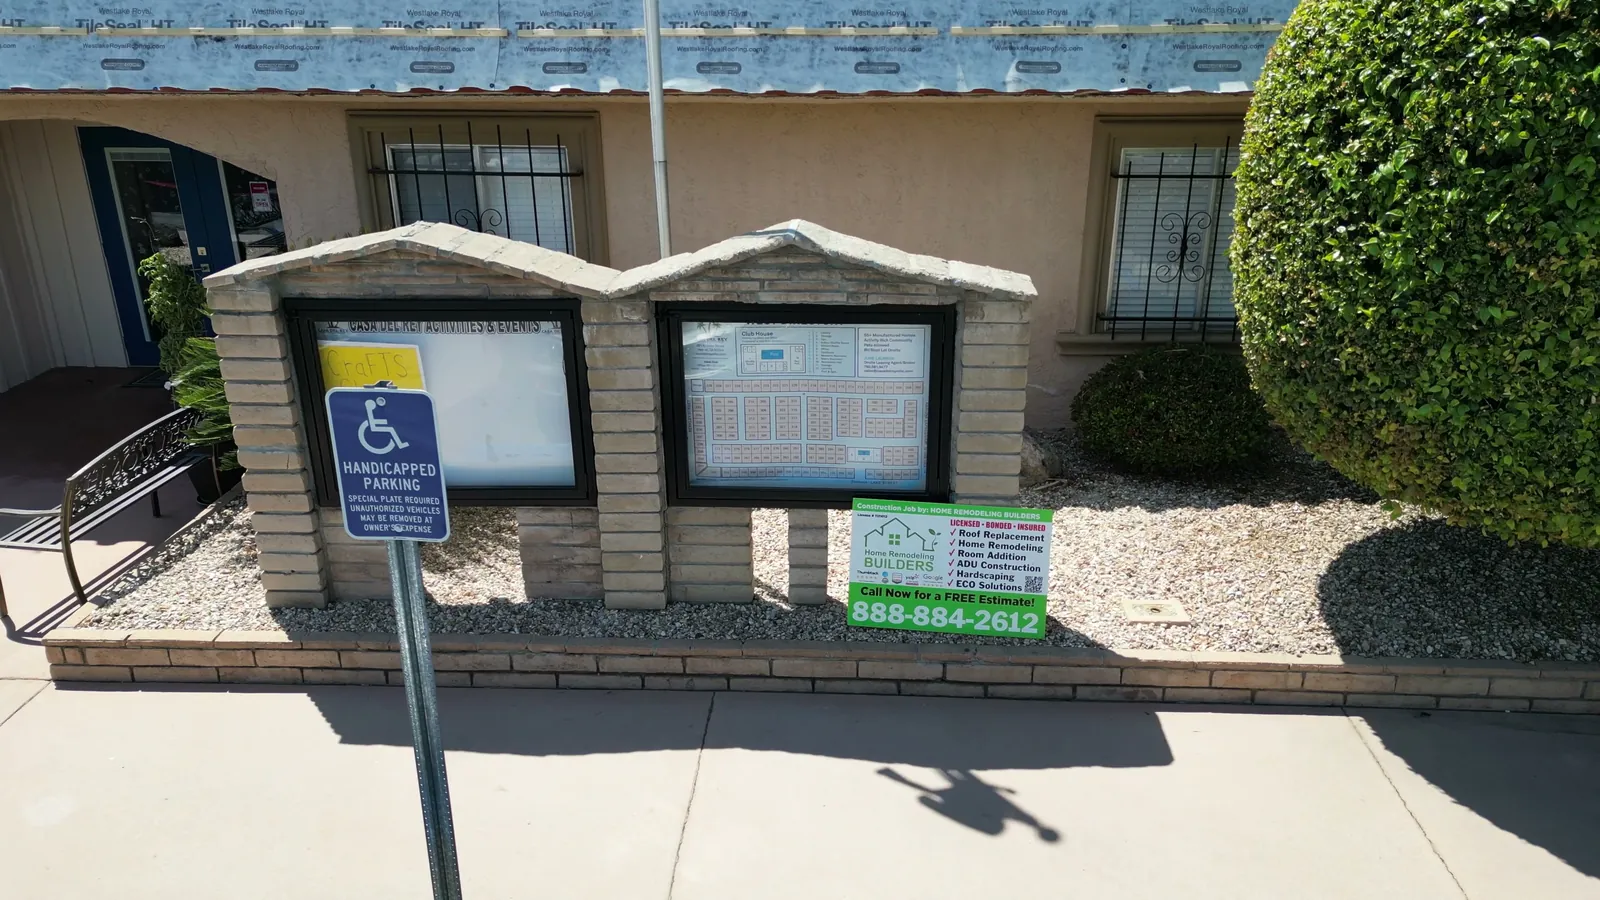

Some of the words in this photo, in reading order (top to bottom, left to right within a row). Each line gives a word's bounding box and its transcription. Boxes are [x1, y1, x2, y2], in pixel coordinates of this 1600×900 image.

[132, 8, 152, 16] Royal
[285, 8, 305, 16] Royal
[407, 9, 439, 17] Westlake
[887, 9, 906, 17] Royal
[1227, 6, 1248, 14] Royal
[349, 321, 378, 334] CASA
[379, 321, 402, 334] DEL
[486, 321, 496, 334] &
[343, 461, 436, 477] HANDICAPPED
[364, 478, 421, 491] PARKING
[348, 495, 377, 503] SPECIAL
[381, 495, 403, 503] PLATE
[405, 496, 440, 505] REQUIRED
[350, 505, 404, 513] UNAUTHORIZED
[406, 506, 440, 515] VEHICLES
[857, 503, 901, 511] Construction
[954, 509, 1002, 518] REMODELING
[1004, 512, 1040, 520] BUILDERS
[390, 515, 422, 523] REMOVED
[402, 525, 432, 533] EXPENSE
[950, 519, 980, 527] LICENSED
[986, 521, 1012, 530] BONDED
[1017, 523, 1046, 532] INSURED
[959, 529, 980, 538] Roof
[984, 531, 1044, 542] Replacement
[958, 539, 985, 548] Home
[988, 541, 1043, 553] Remodeling
[865, 549, 886, 557] Home
[889, 550, 934, 561] Remodeling
[958, 550, 984, 558] Room
[987, 552, 1026, 561] Addition
[864, 557, 934, 572] BUILDERS
[957, 560, 977, 568] ADU
[981, 561, 1041, 573] Construction
[956, 570, 1015, 582] Hardscaping
[956, 580, 976, 588] ECO
[979, 581, 1022, 591] Solutions
[861, 587, 882, 596] Call
[886, 588, 911, 598] Now
[915, 590, 931, 599] for
[945, 593, 976, 603] FREE
[979, 595, 1035, 607] Estimate!
[852, 601, 1039, 634] 888-884-2612
